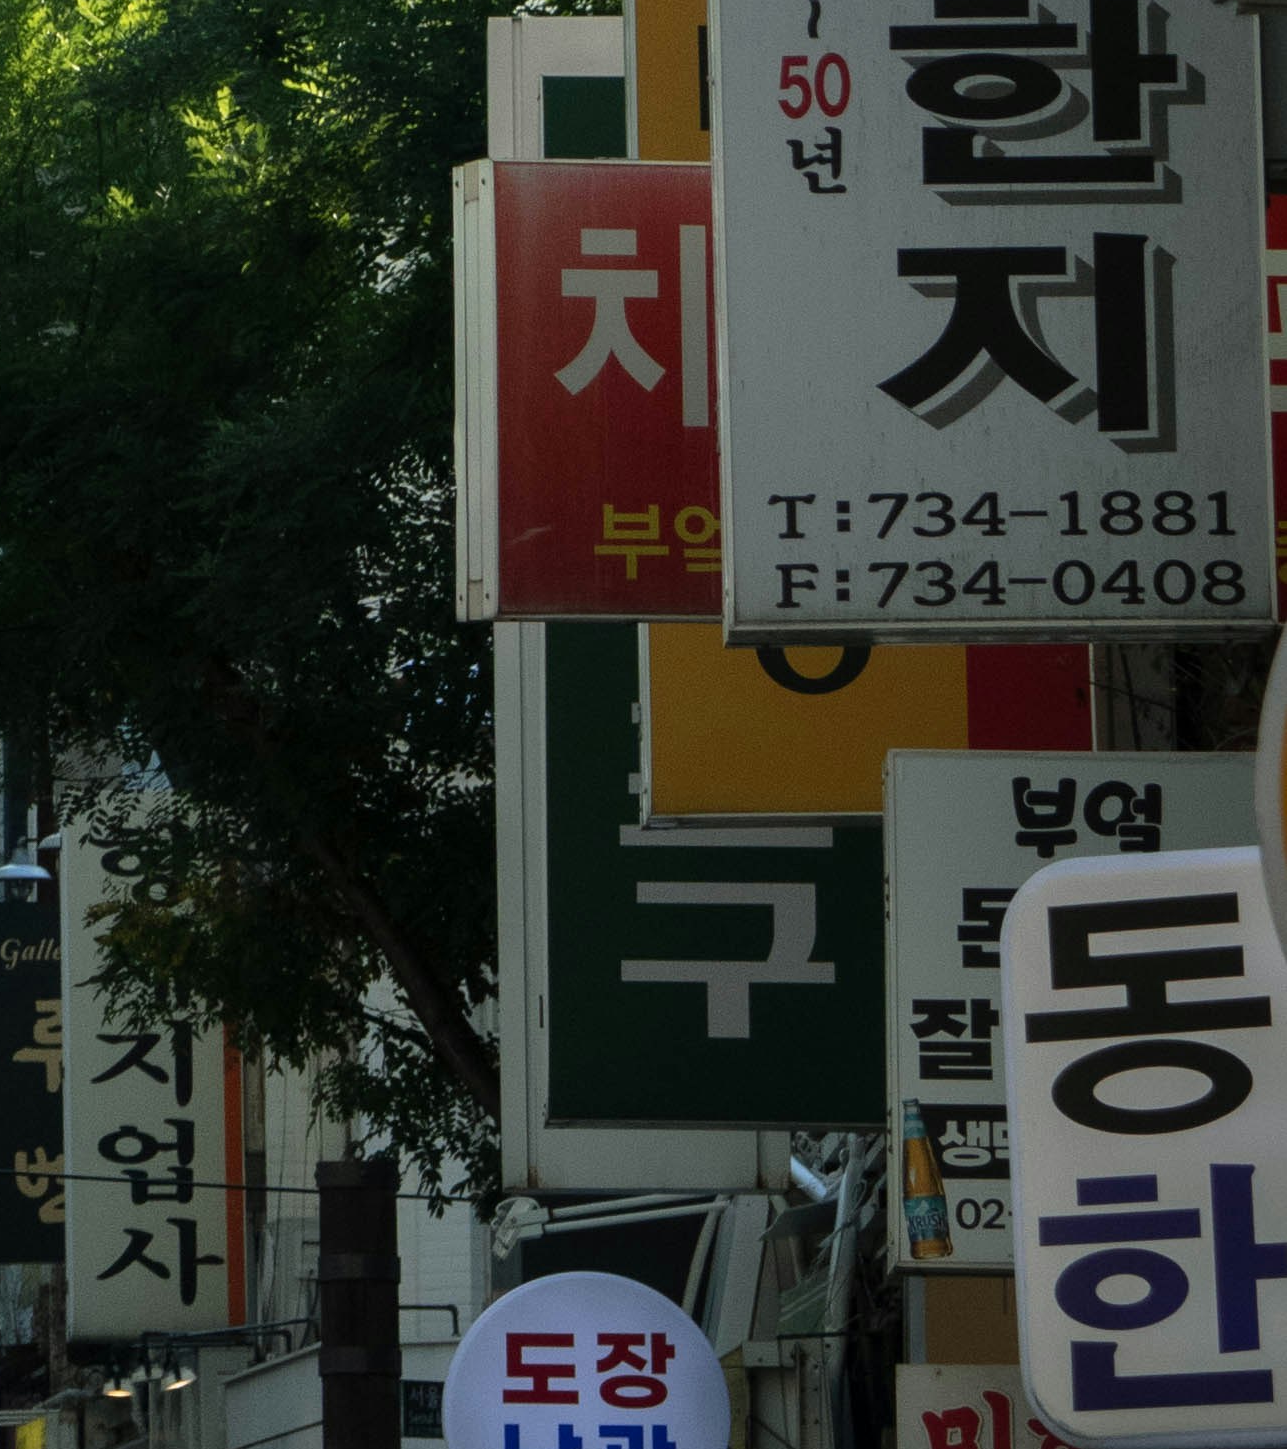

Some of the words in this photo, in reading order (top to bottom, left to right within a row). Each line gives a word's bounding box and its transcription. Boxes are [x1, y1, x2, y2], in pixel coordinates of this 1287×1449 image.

[766, 491, 1237, 542] T:734-1881
[774, 557, 1247, 609] F:734-0408
[909, 999, 1000, 1081] 잘
[502, 1332, 676, 1409] 도장
